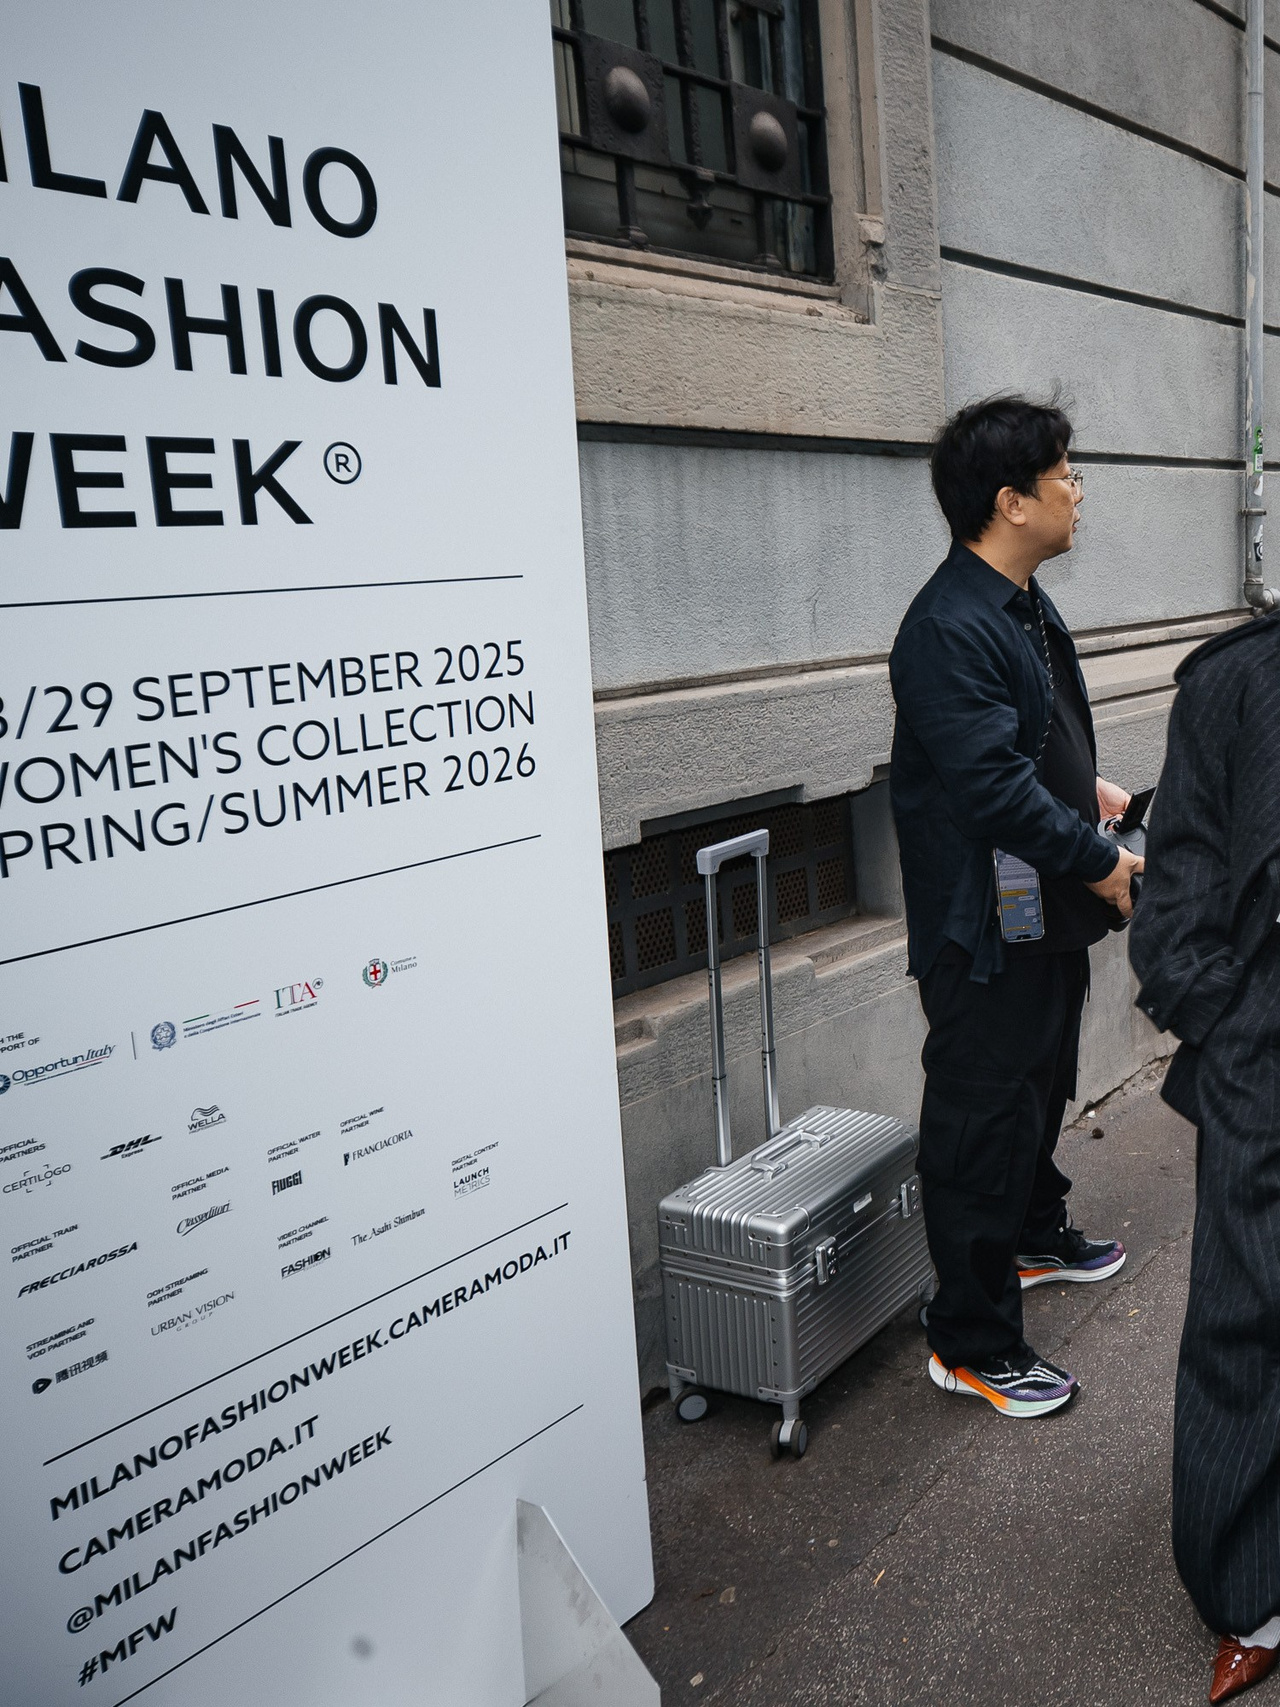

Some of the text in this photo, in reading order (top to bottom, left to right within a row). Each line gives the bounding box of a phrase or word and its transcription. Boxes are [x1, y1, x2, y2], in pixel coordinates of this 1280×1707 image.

[0, 82, 377, 238] LANO
[0, 640, 524, 739] /29 SEPTEMBER 2025
[257, 691, 534, 766] COLLECTION
[444, 743, 535, 792] 2026
[391, 961, 418, 974] Milano
[274, 982, 316, 1009] ITA
[6, 1032, 24, 1042] THE
[28, 1037, 39, 1045] OF
[188, 1114, 225, 1130] WELLA
[340, 1107, 384, 1127] OFFICIAL WINE
[341, 1120, 369, 1134] PARTNER
[107, 1135, 155, 1157] DHL
[268, 1131, 320, 1155] OFFICIAL WATER
[452, 1142, 498, 1166] DIGITAL CONTENT
[268, 1148, 298, 1163] PARTNER
[452, 1158, 477, 1172] PARTNER
[3, 1164, 71, 1193] CERTILOGO
[171, 1167, 229, 1192] OFFICIAL MEDIA
[454, 1167, 489, 1188] LAUNCH
[172, 1183, 206, 1200] PARTNER
[11, 1224, 78, 1254] OFFICIAL TRAIN
[277, 1217, 329, 1241] VIDEO CHANNEL
[351, 1209, 425, 1247] The Asahi Shimbun
[12, 1243, 53, 1262] PARTNER
[278, 1231, 313, 1250] PARTNERS
[18, 1242, 137, 1298] FRECCIAROSSA
[165, 1268, 208, 1291] STREAMING
[148, 1288, 182, 1307] PARTNER
[151, 1291, 235, 1336] URBAN VISION
[26, 1318, 95, 1351] STREAMING AND
[27, 1331, 86, 1360] VOD PARTNER
[50, 1231, 571, 1521] MILANOFASHIONWEEK.CAMERAMODA.IT
[58, 1415, 318, 1574] CAMERAMODA.IT
[66, 1426, 392, 1634] @MILANFASHIONWEEK
[78, 1607, 177, 1687] #MFW
